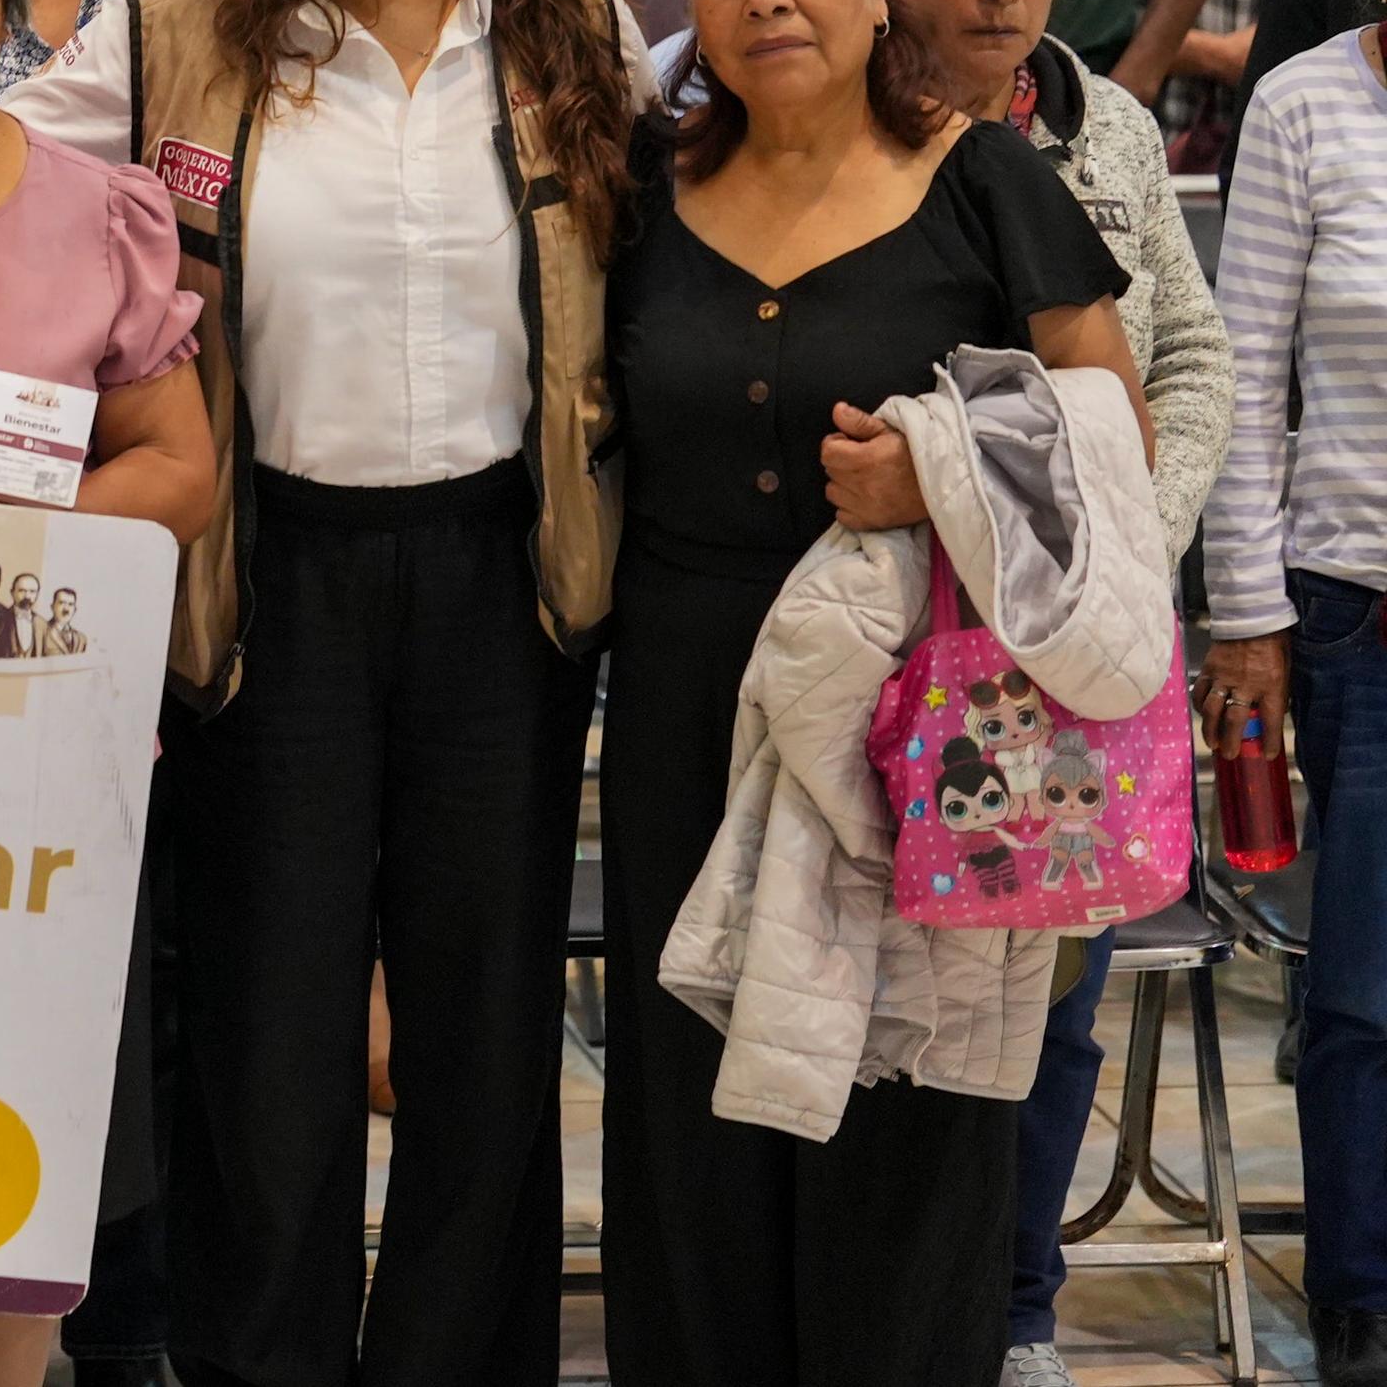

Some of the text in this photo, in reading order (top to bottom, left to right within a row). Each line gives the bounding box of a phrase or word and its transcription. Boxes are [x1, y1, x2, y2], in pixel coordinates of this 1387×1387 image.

[165, 146, 226, 176] GOBIERNO
[163, 165, 223, 201] MÉXIC
[3, 414, 63, 435] Bienestar
